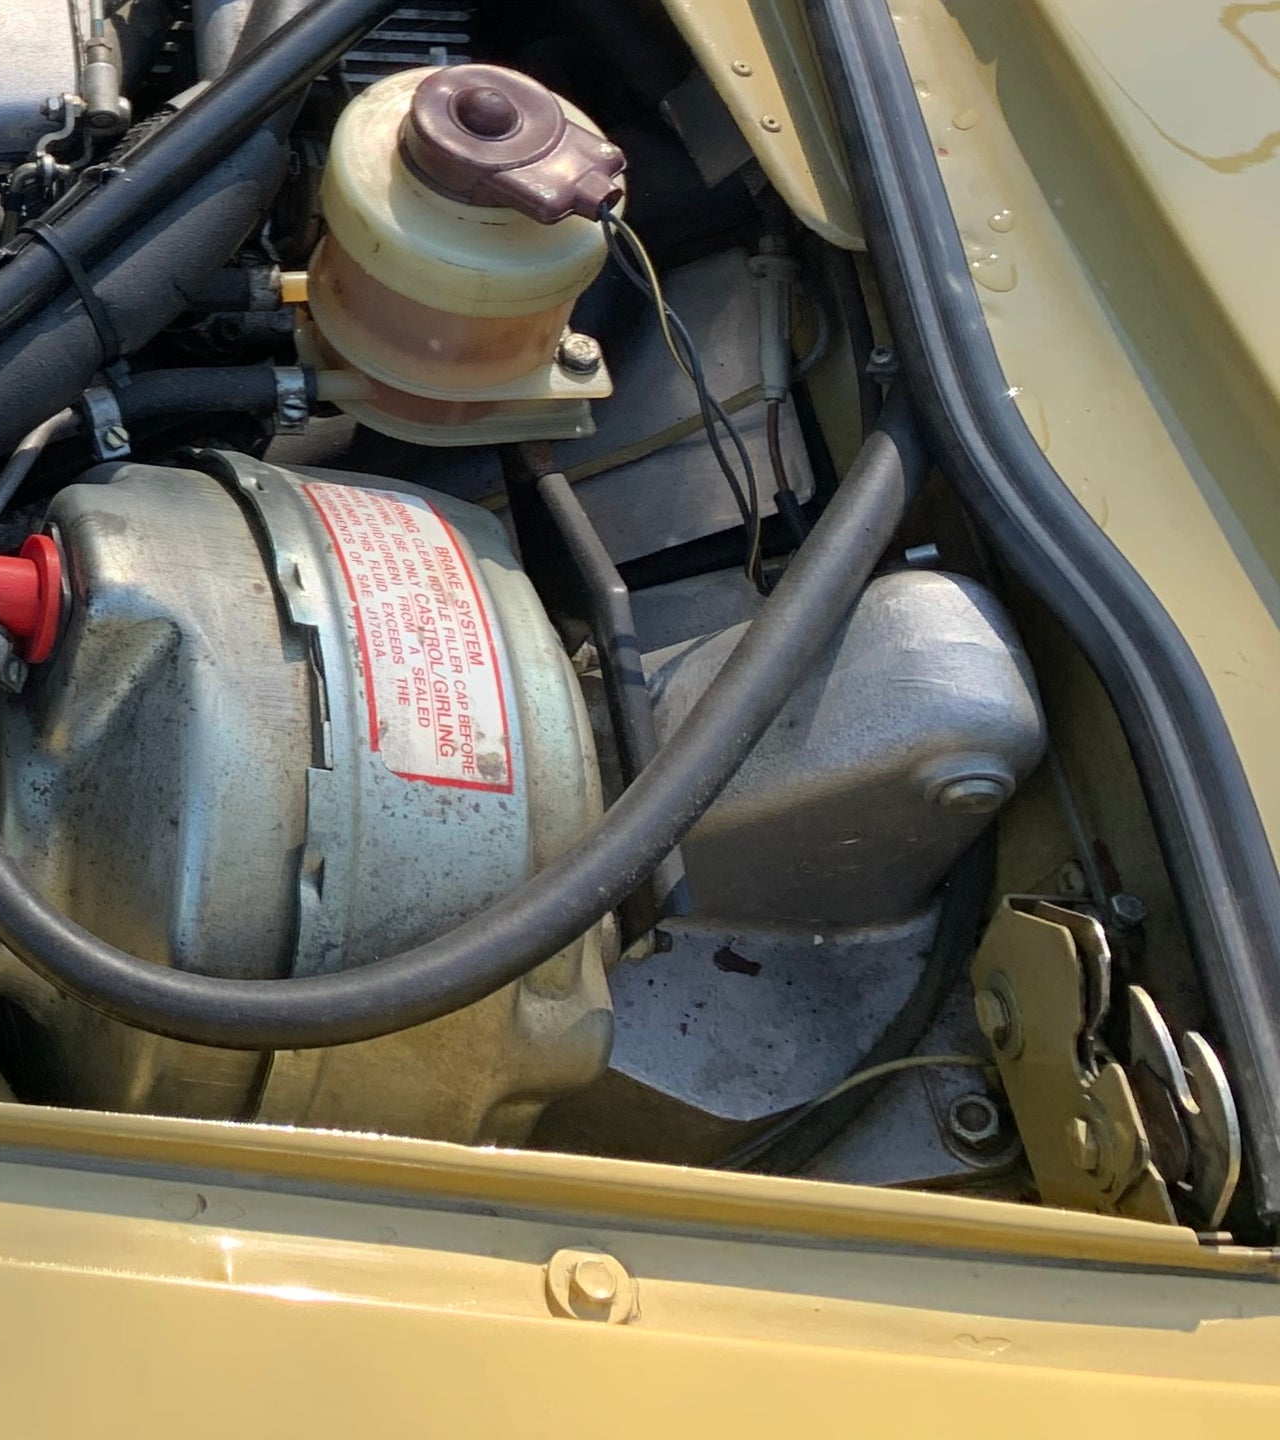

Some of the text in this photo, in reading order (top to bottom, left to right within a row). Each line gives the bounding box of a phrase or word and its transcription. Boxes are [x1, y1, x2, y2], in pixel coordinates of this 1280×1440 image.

[349, 550, 364, 567] OF
[412, 537, 435, 572] CLEAN
[356, 573, 374, 598] SAE
[427, 574, 452, 622] BOTTLE
[434, 546, 485, 667] BRAKE SYSTEM
[357, 530, 375, 552] THIS
[368, 559, 389, 592] FLUID
[381, 601, 406, 665] EXCEEDS
[395, 676, 411, 707] THE
[396, 595, 416, 633] FROM
[391, 533, 410, 553] USE
[402, 558, 424, 589] ONLY
[413, 593, 457, 758] CASTROL/GIRLING
[407, 645, 421, 656] A
[442, 626, 464, 674] FILLER
[412, 666, 431, 729] SEALED
[453, 679, 470, 711] CAP
[457, 714, 475, 775] BEFORE
